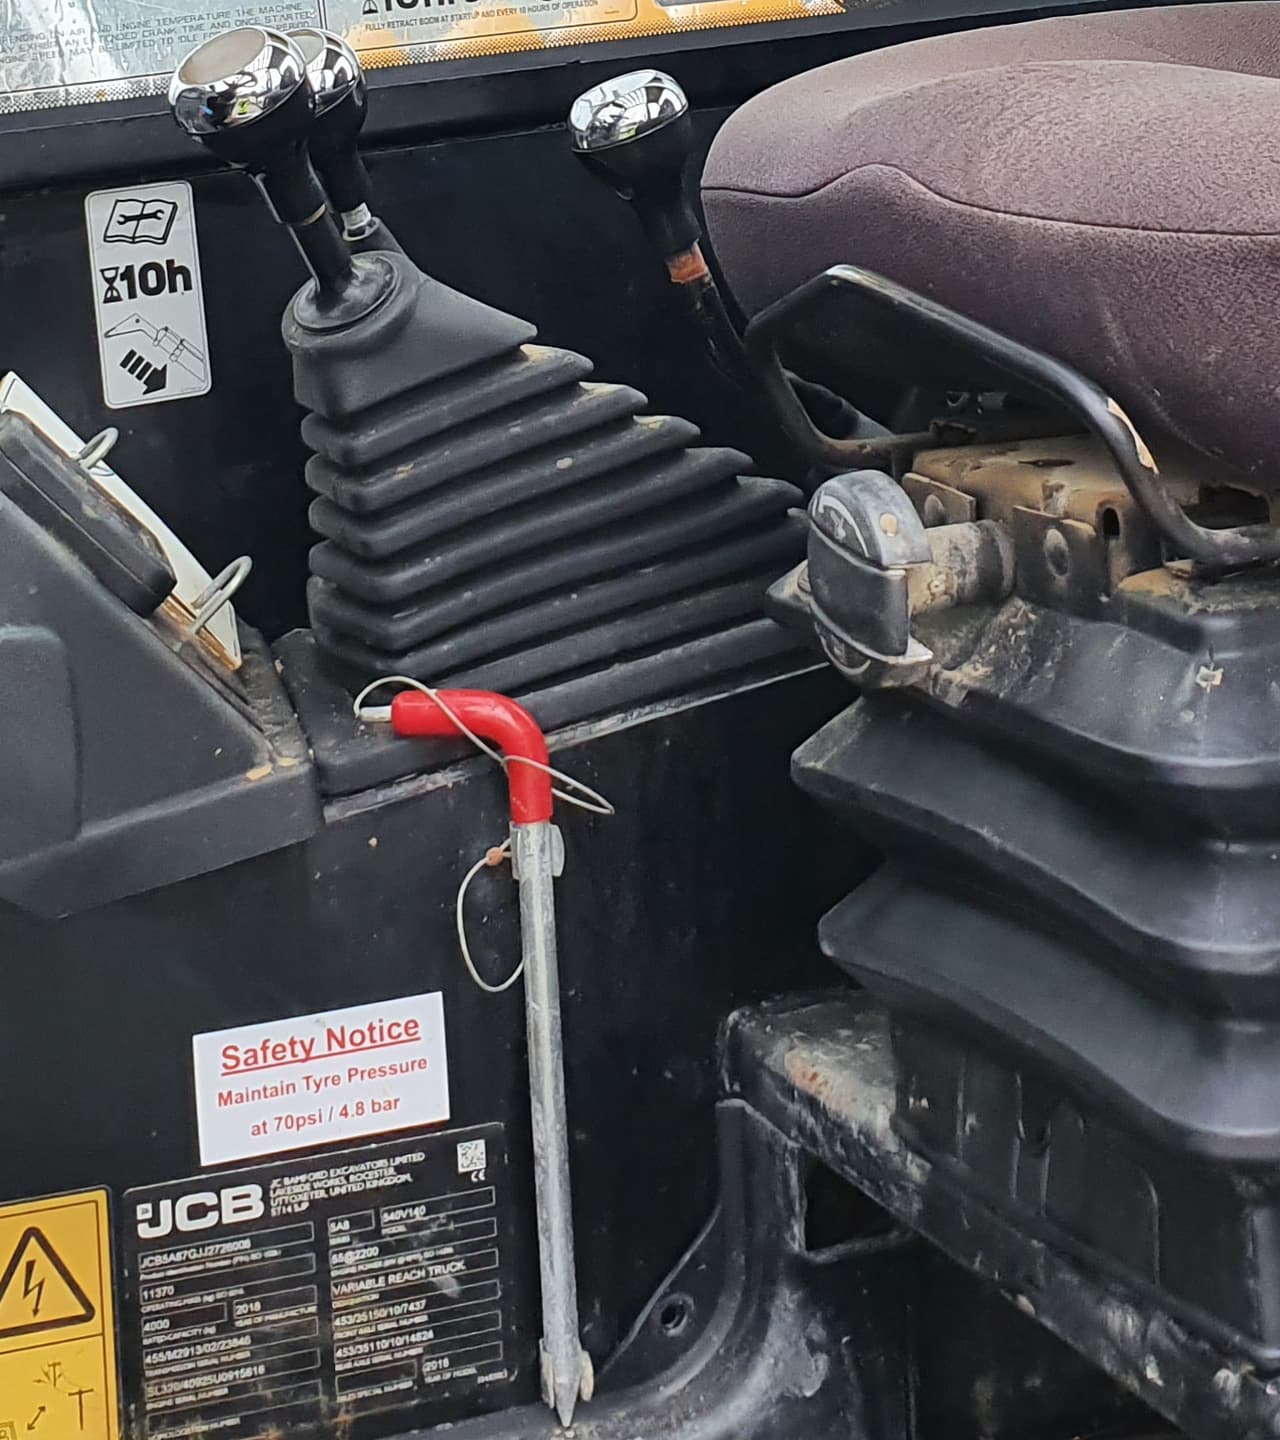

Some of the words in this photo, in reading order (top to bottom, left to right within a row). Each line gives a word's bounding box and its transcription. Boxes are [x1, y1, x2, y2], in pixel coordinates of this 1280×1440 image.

[142, 28, 177, 39] CRANK
[183, 23, 207, 34] TIME
[210, 20, 231, 30] AND
[235, 16, 261, 27] ONCE
[156, 11, 231, 27] TEMPERATURE
[236, 7, 257, 18] THE
[259, 2, 303, 15] MACHINE
[120, 259, 193, 300] 10h
[221, 1035, 316, 1072] Safety
[326, 1018, 420, 1052] Notice
[218, 1080, 297, 1107] Maintain
[303, 1073, 341, 1094] Tyre
[347, 1058, 428, 1083] Pressure
[251, 1121, 268, 1137] at
[274, 1109, 323, 1132] 70psi
[339, 1101, 365, 1120] 4.8
[371, 1096, 401, 1113] bar
[136, 1184, 265, 1239] JCB
[332, 1277, 386, 1295] VARIABLE
[388, 1269, 425, 1287] REACH
[428, 1260, 466, 1277] TRUCK
